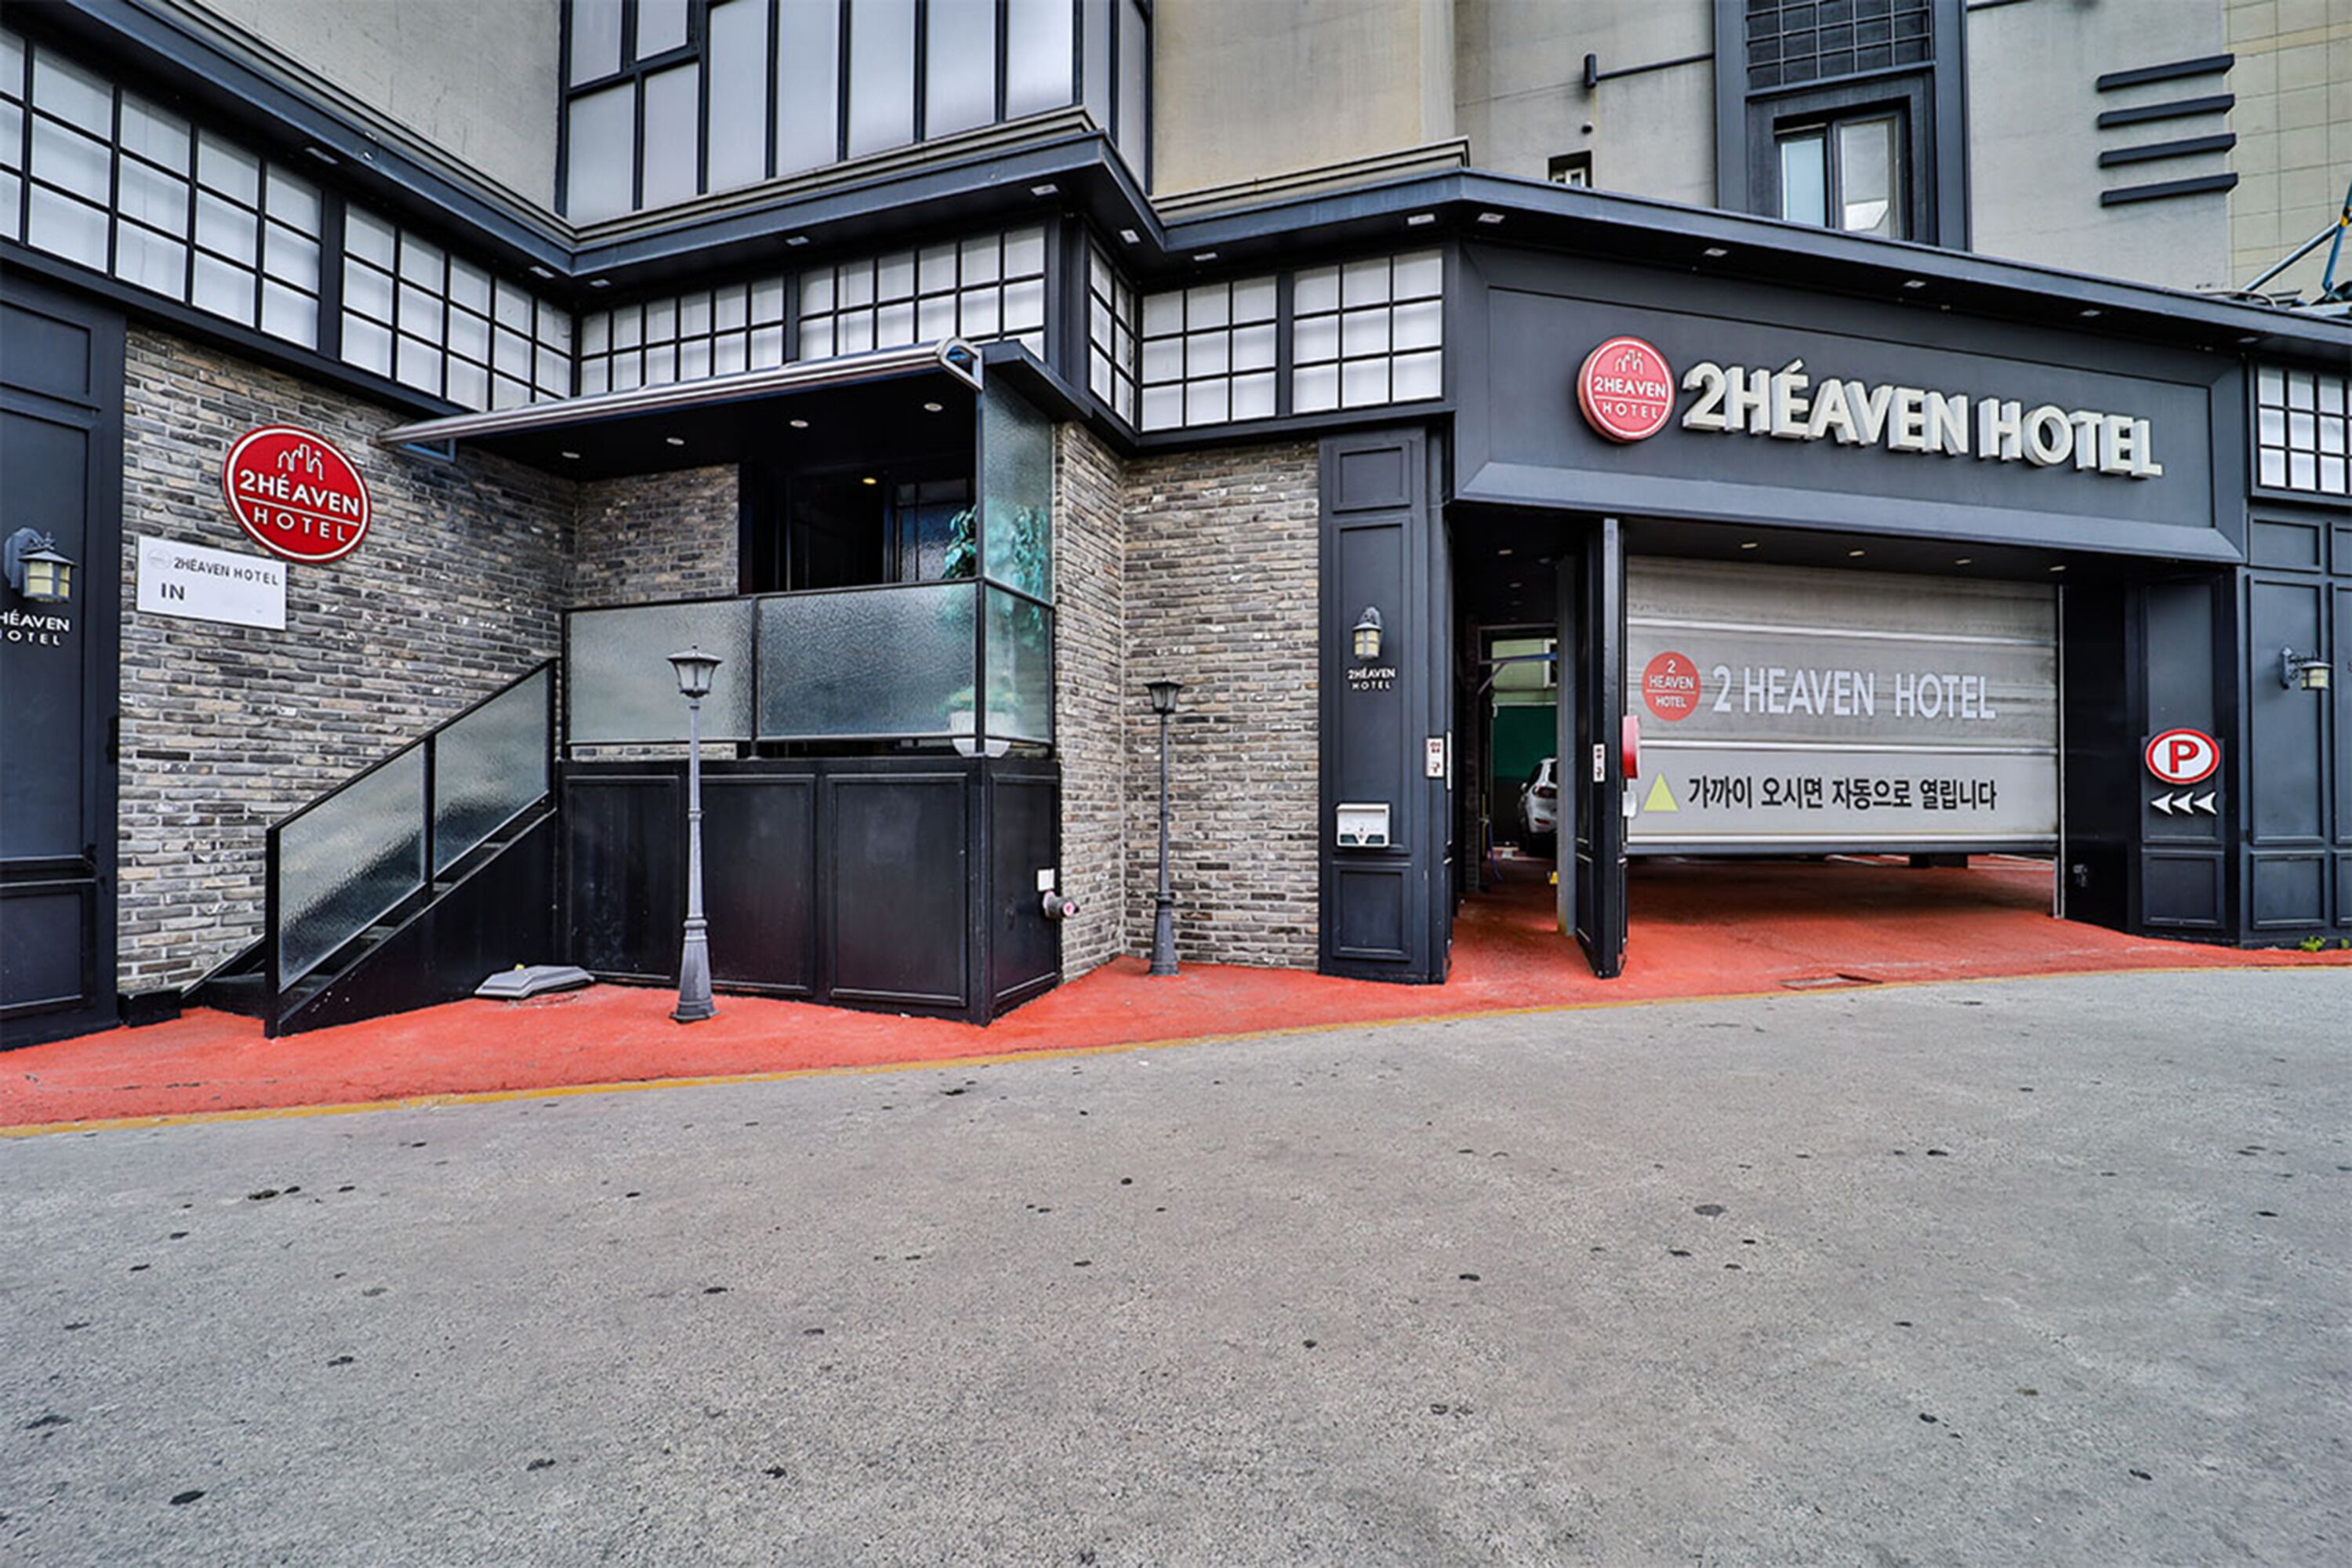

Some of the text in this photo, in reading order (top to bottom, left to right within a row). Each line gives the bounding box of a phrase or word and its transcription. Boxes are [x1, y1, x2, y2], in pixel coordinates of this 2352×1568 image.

[1602, 401, 1657, 419] HOTEL
[1682, 358, 2163, 477] 2HÉAVEN HOTEL
[239, 469, 359, 517] 2HÉAVEN
[253, 506, 346, 543] HOTEL
[234, 568, 279, 586] HOTEL
[161, 583, 185, 601] IN
[1667, 659, 1676, 673] 2
[1352, 680, 1391, 690] HOTEL
[1649, 675, 1694, 689] HEAVEN
[1712, 665, 1996, 719] 2 HEAVEN HOTEL
[1655, 696, 1687, 708] HOTEL
[2169, 740, 2200, 773] P
[1688, 775, 1997, 811] 가까이 오시면 자동으로 열립니다
